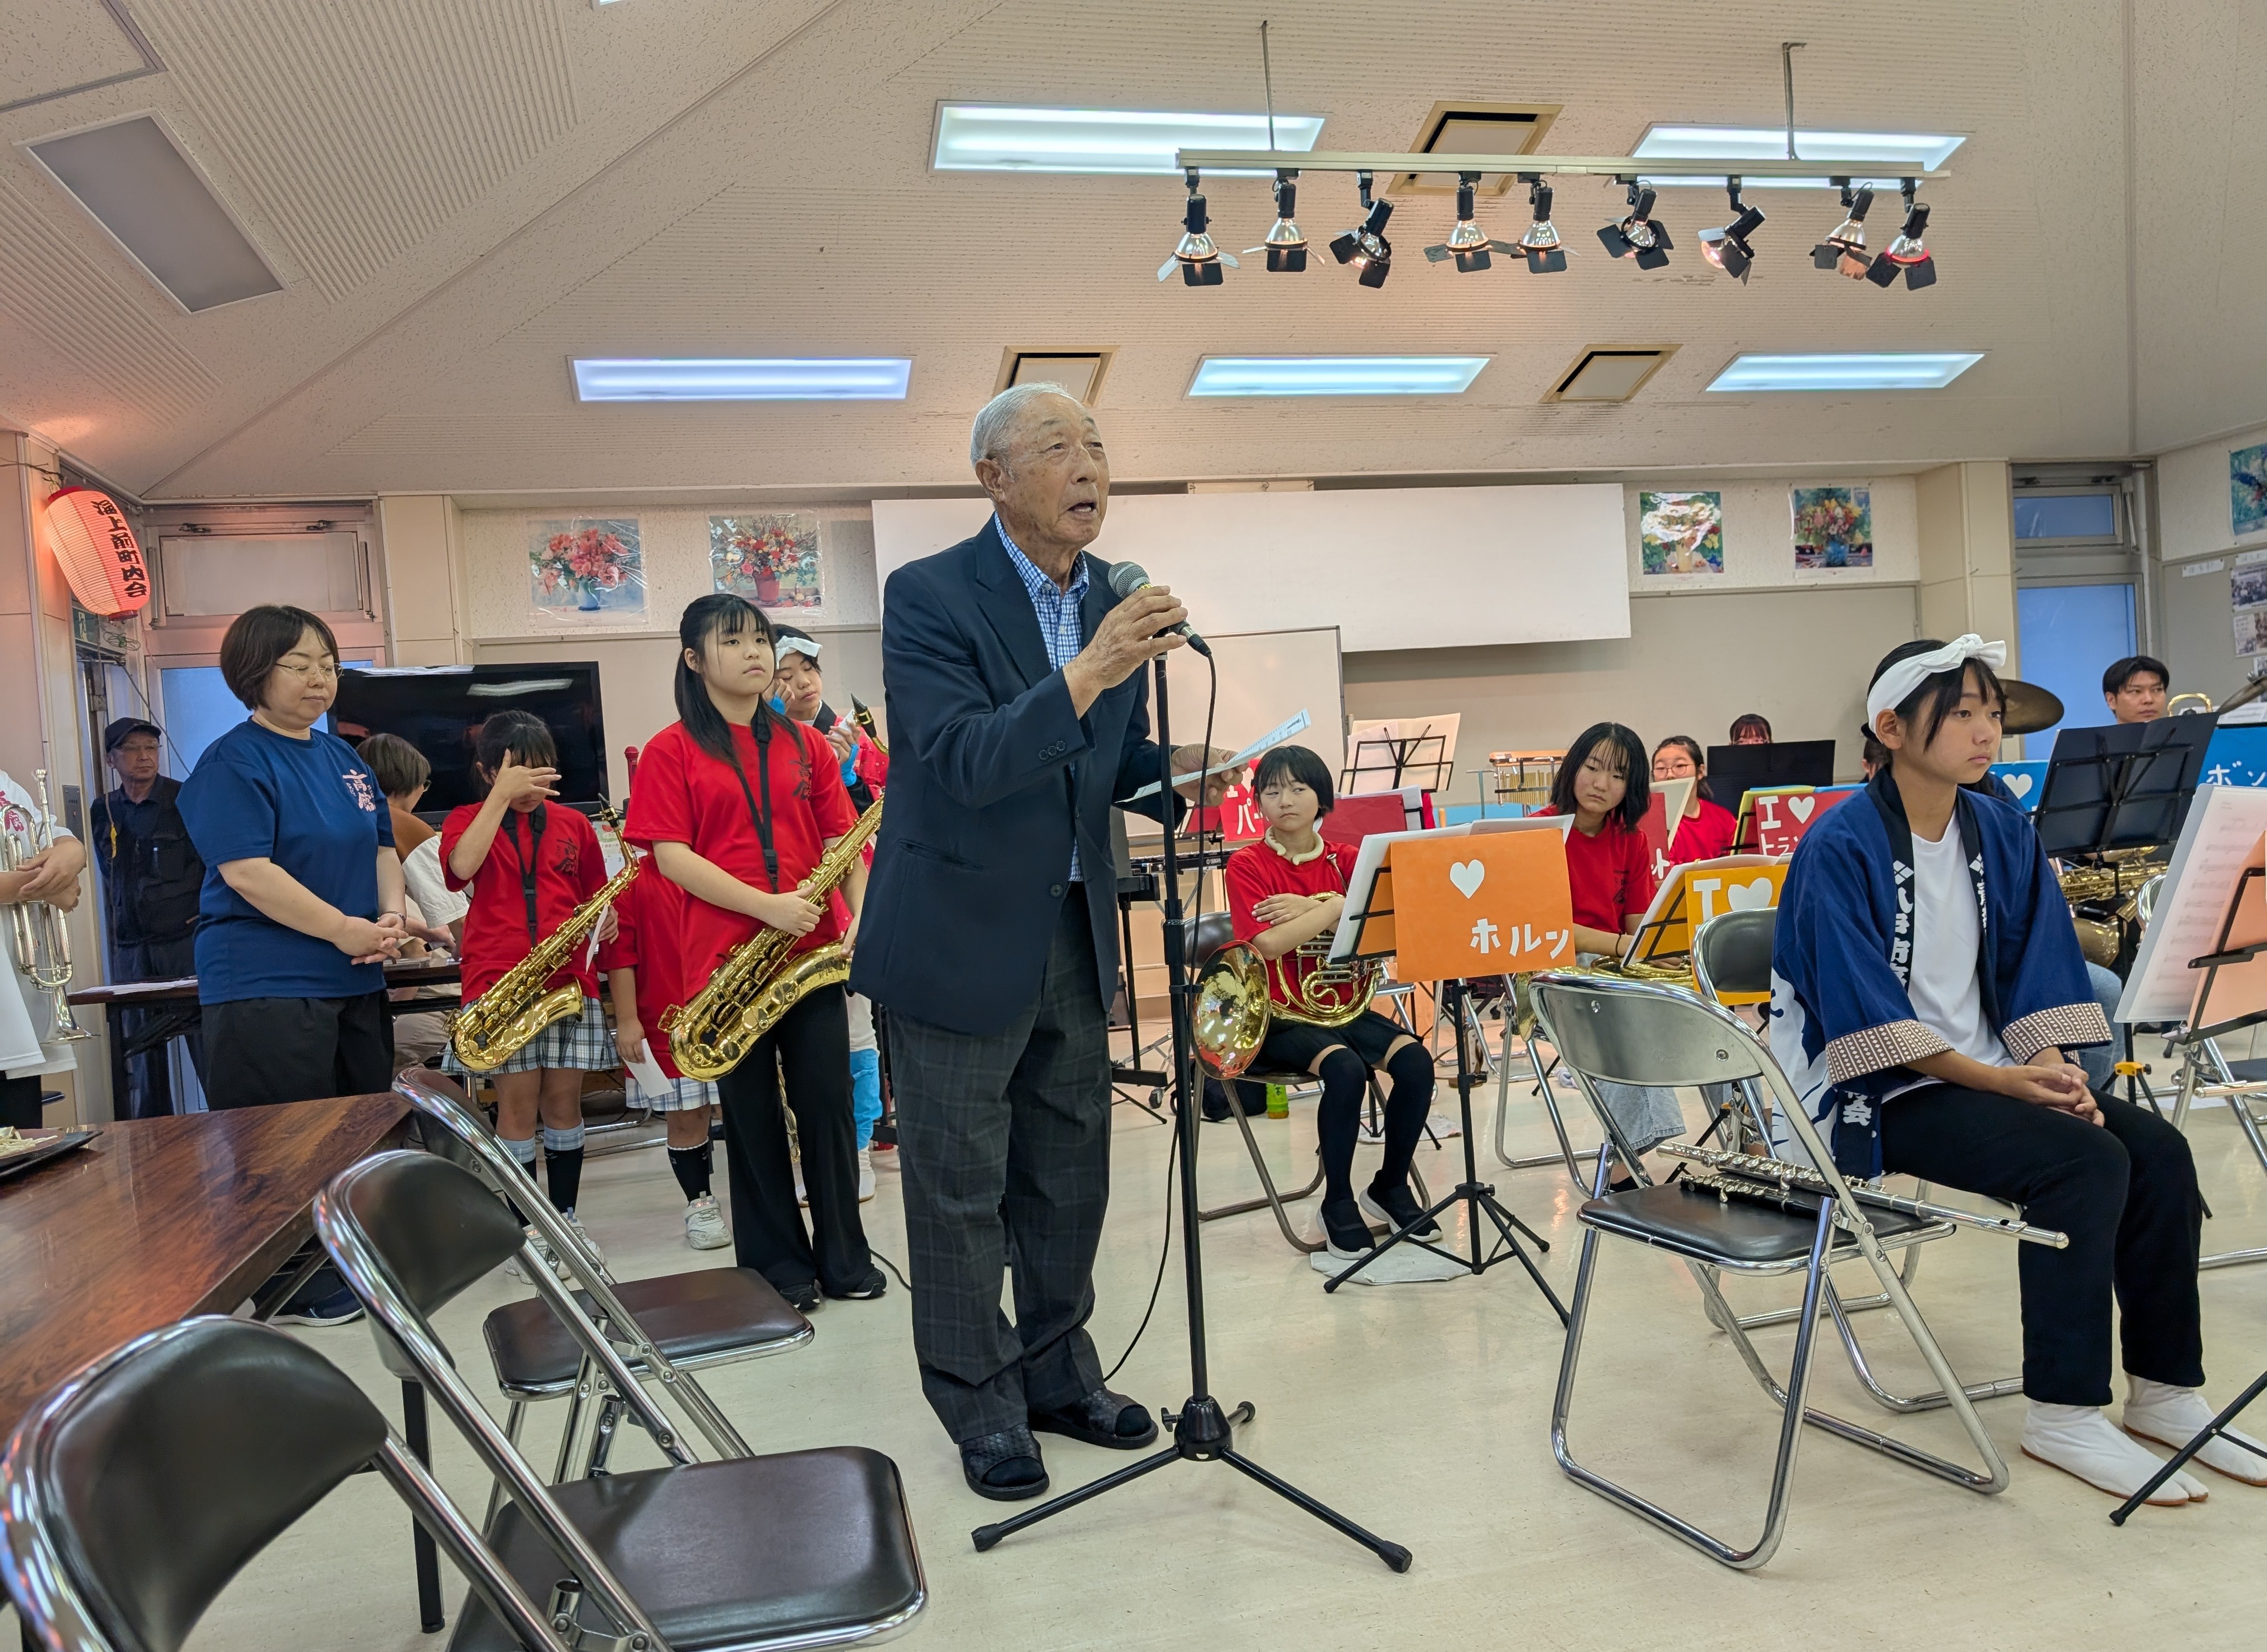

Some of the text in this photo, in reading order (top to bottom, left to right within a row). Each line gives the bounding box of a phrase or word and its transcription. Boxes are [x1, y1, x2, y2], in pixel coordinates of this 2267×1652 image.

[1759, 795, 1781, 830] I
[1470, 918, 1569, 959] ホルン
